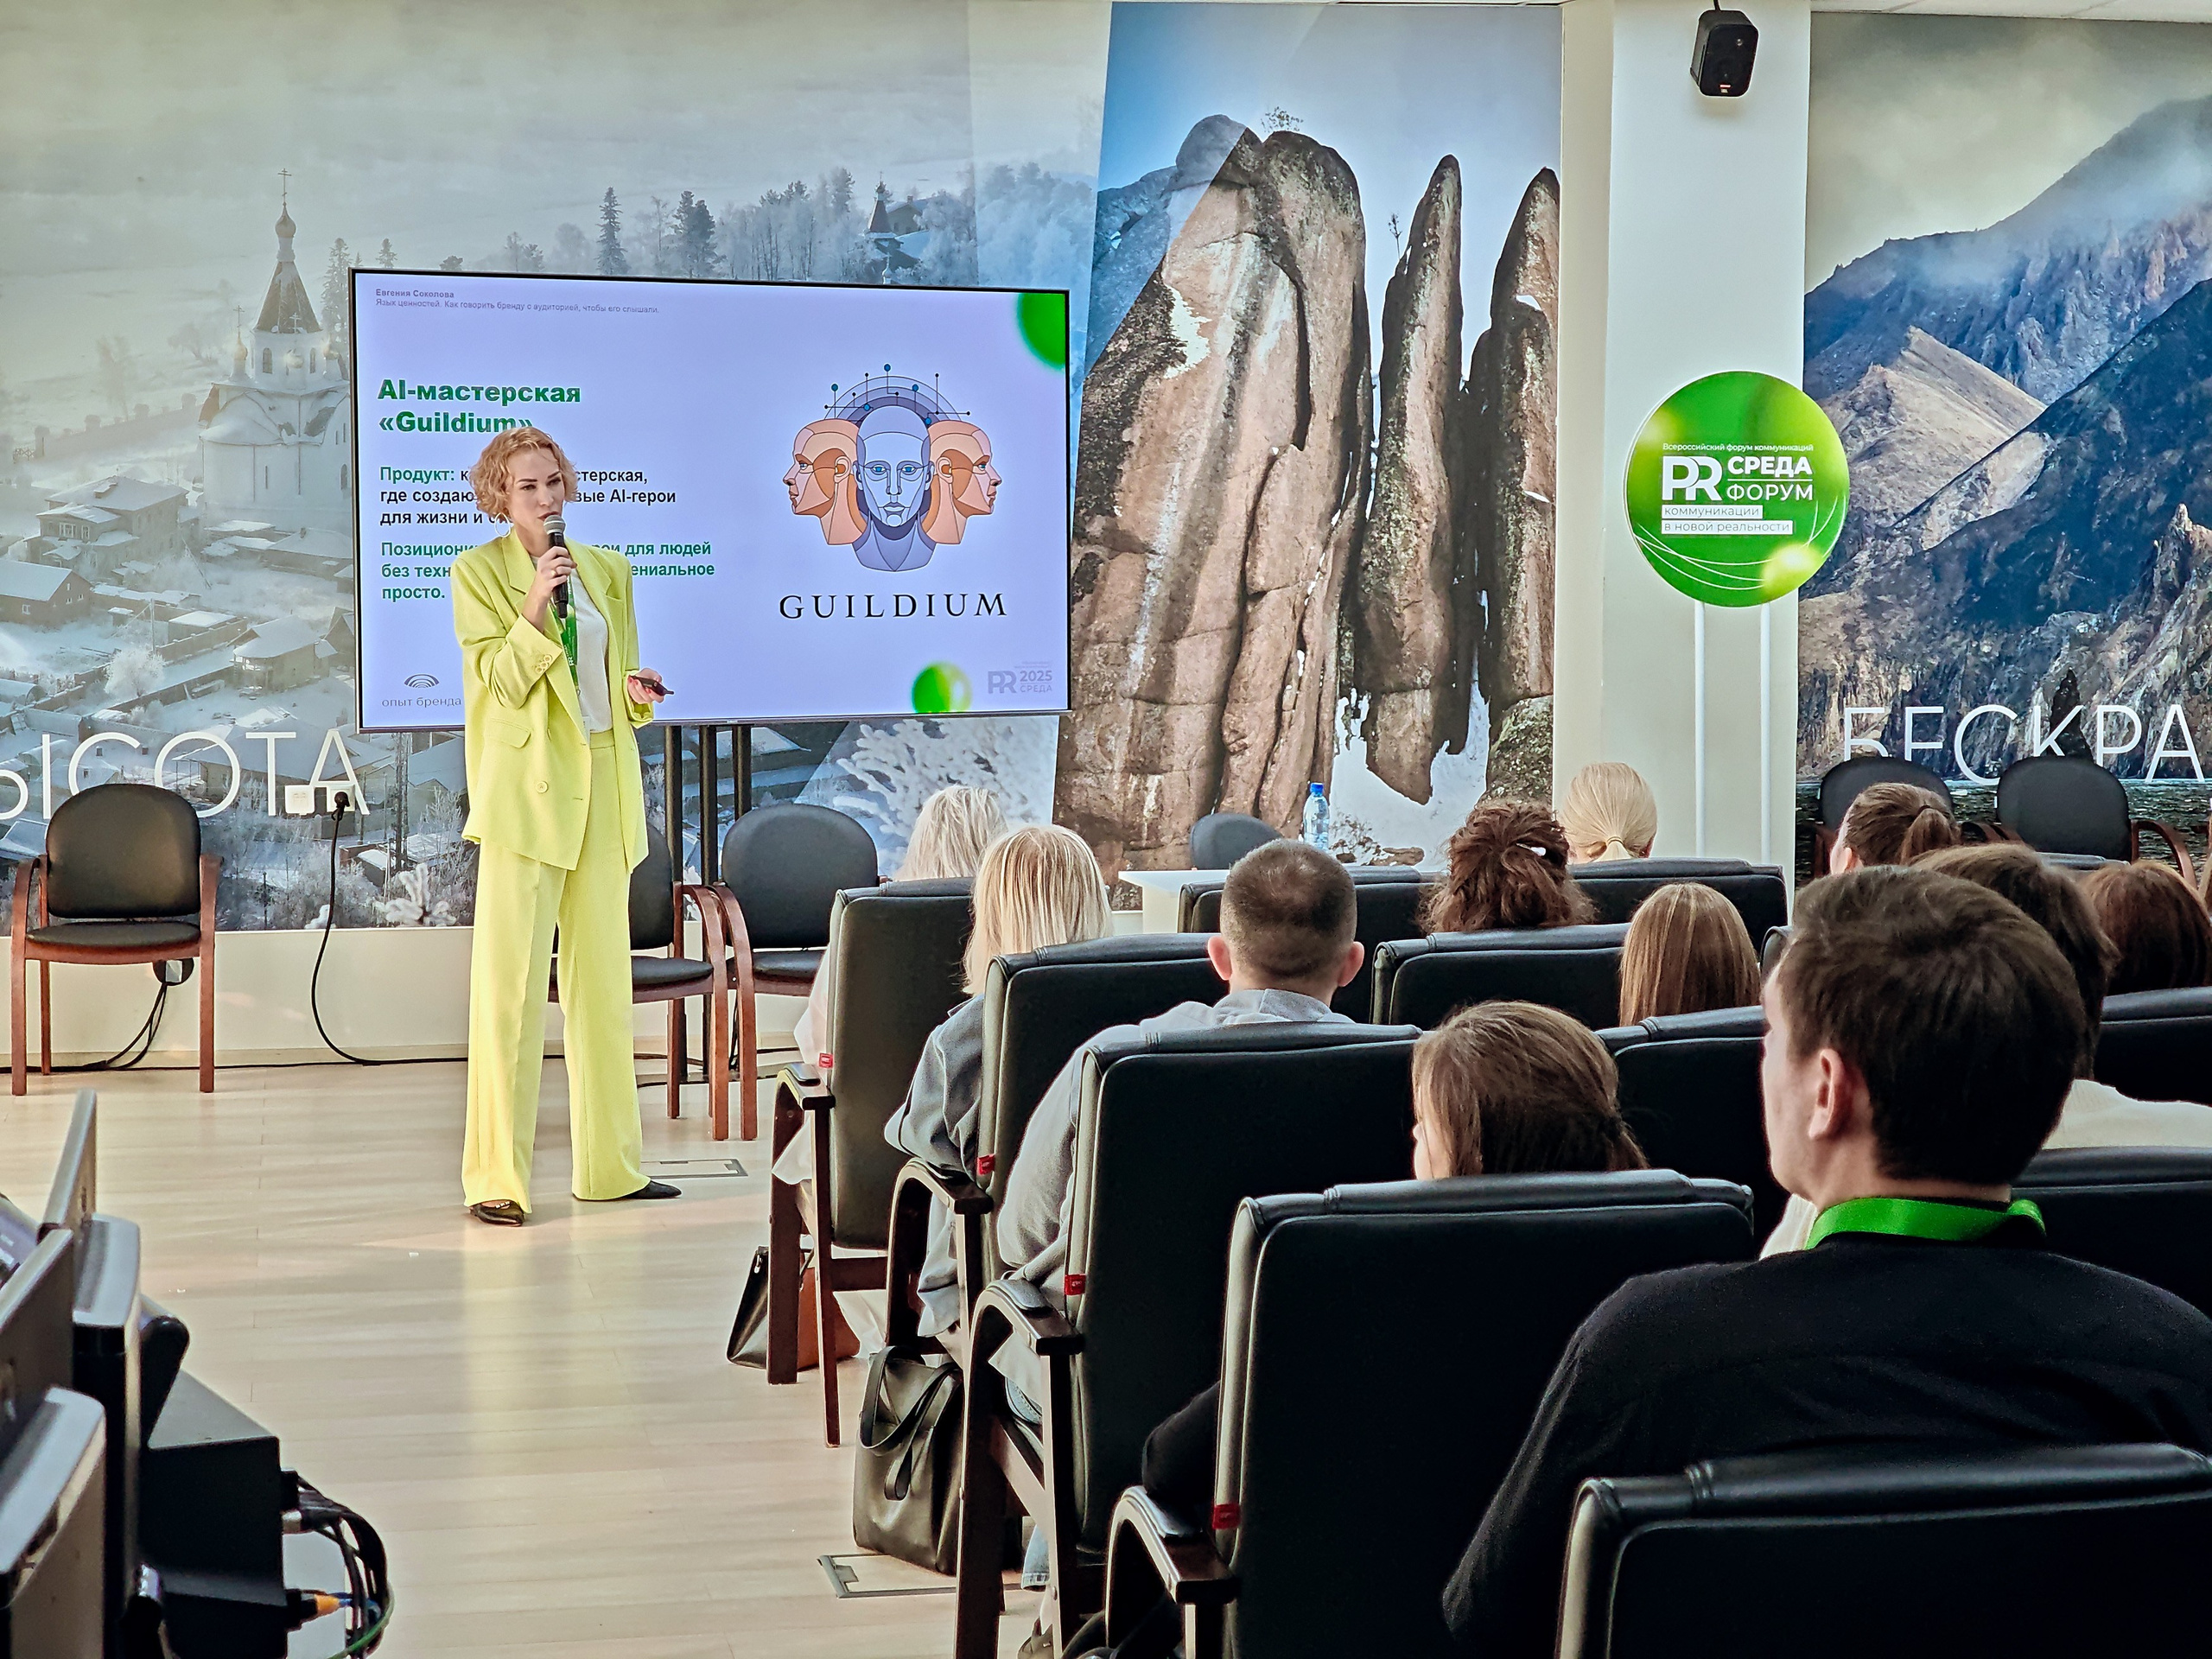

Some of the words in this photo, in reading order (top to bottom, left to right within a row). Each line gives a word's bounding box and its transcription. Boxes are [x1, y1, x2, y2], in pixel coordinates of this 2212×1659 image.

[376, 289, 410, 297] Евгения
[413, 289, 454, 298] Соколова
[461, 302, 495, 310] говорить
[497, 302, 524, 311] бренду
[378, 378, 581, 407] AI-мастерская
[1662, 442, 1726, 452] Всероссийский
[1726, 443, 1753, 453] форум
[1754, 443, 1814, 452] коммуникаций
[1727, 455, 1813, 478] СРЕДА
[380, 467, 454, 484] Продукт:
[1662, 456, 1723, 501] PR
[380, 491, 407, 505] где
[610, 489, 676, 506] AI-герои
[1726, 484, 1813, 501] ФОРУМ
[380, 513, 411, 525] для
[416, 513, 467, 524] жизни
[474, 513, 483, 524] и
[1664, 507, 1760, 518] коммуникации
[1664, 522, 1670, 531] в
[1675, 521, 1714, 532] новой
[1717, 522, 1789, 534] реальности
[625, 544, 654, 557] для
[659, 541, 711, 557] людей
[381, 563, 410, 578] без
[382, 588, 445, 603] просто.
[779, 593, 1007, 620] GUILDIUM
[988, 671, 1017, 694] PR
[1020, 670, 1052, 682] 2025
[382, 698, 413, 708] опыт
[416, 696, 461, 709] бренда
